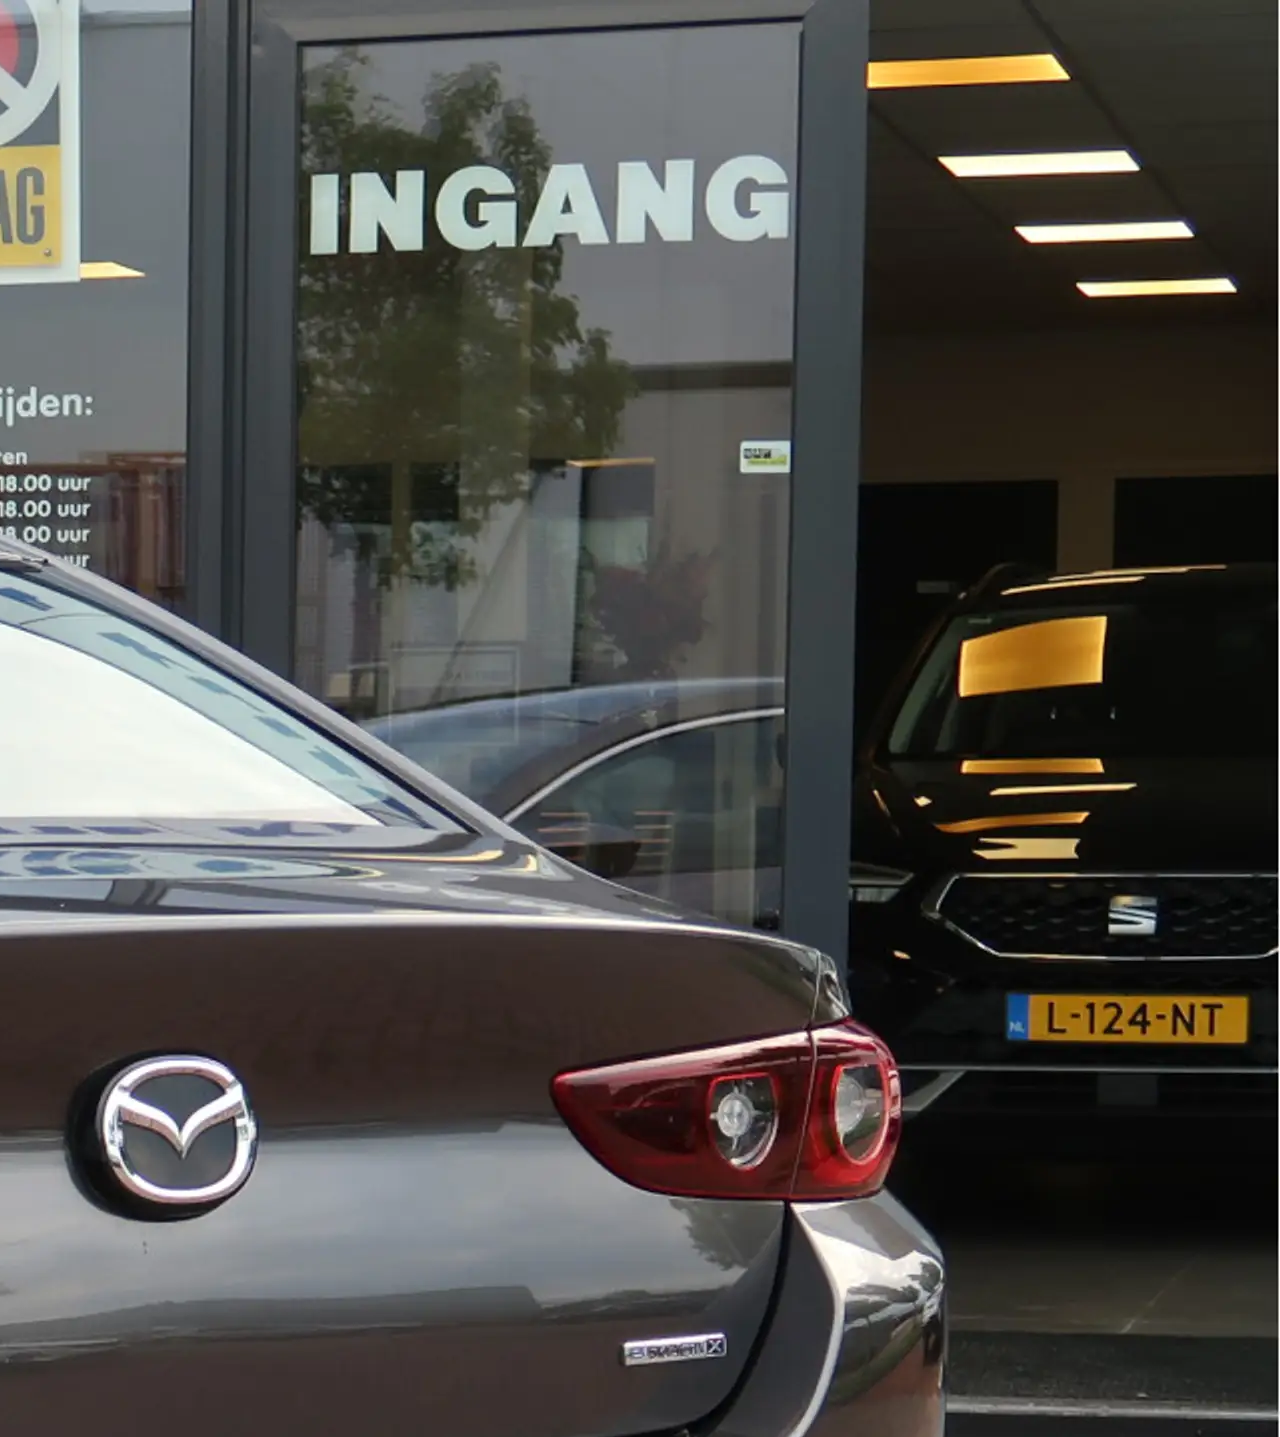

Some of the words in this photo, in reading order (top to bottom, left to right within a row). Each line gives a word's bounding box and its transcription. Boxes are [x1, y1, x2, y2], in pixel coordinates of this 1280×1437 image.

[310, 154, 789, 256] INGANG
[57, 478, 91, 491] uur
[57, 504, 91, 517] uur
[57, 529, 90, 542] uur
[1048, 1001, 1223, 1036] L-124-NT
[1009, 1021, 1025, 1033] NL
